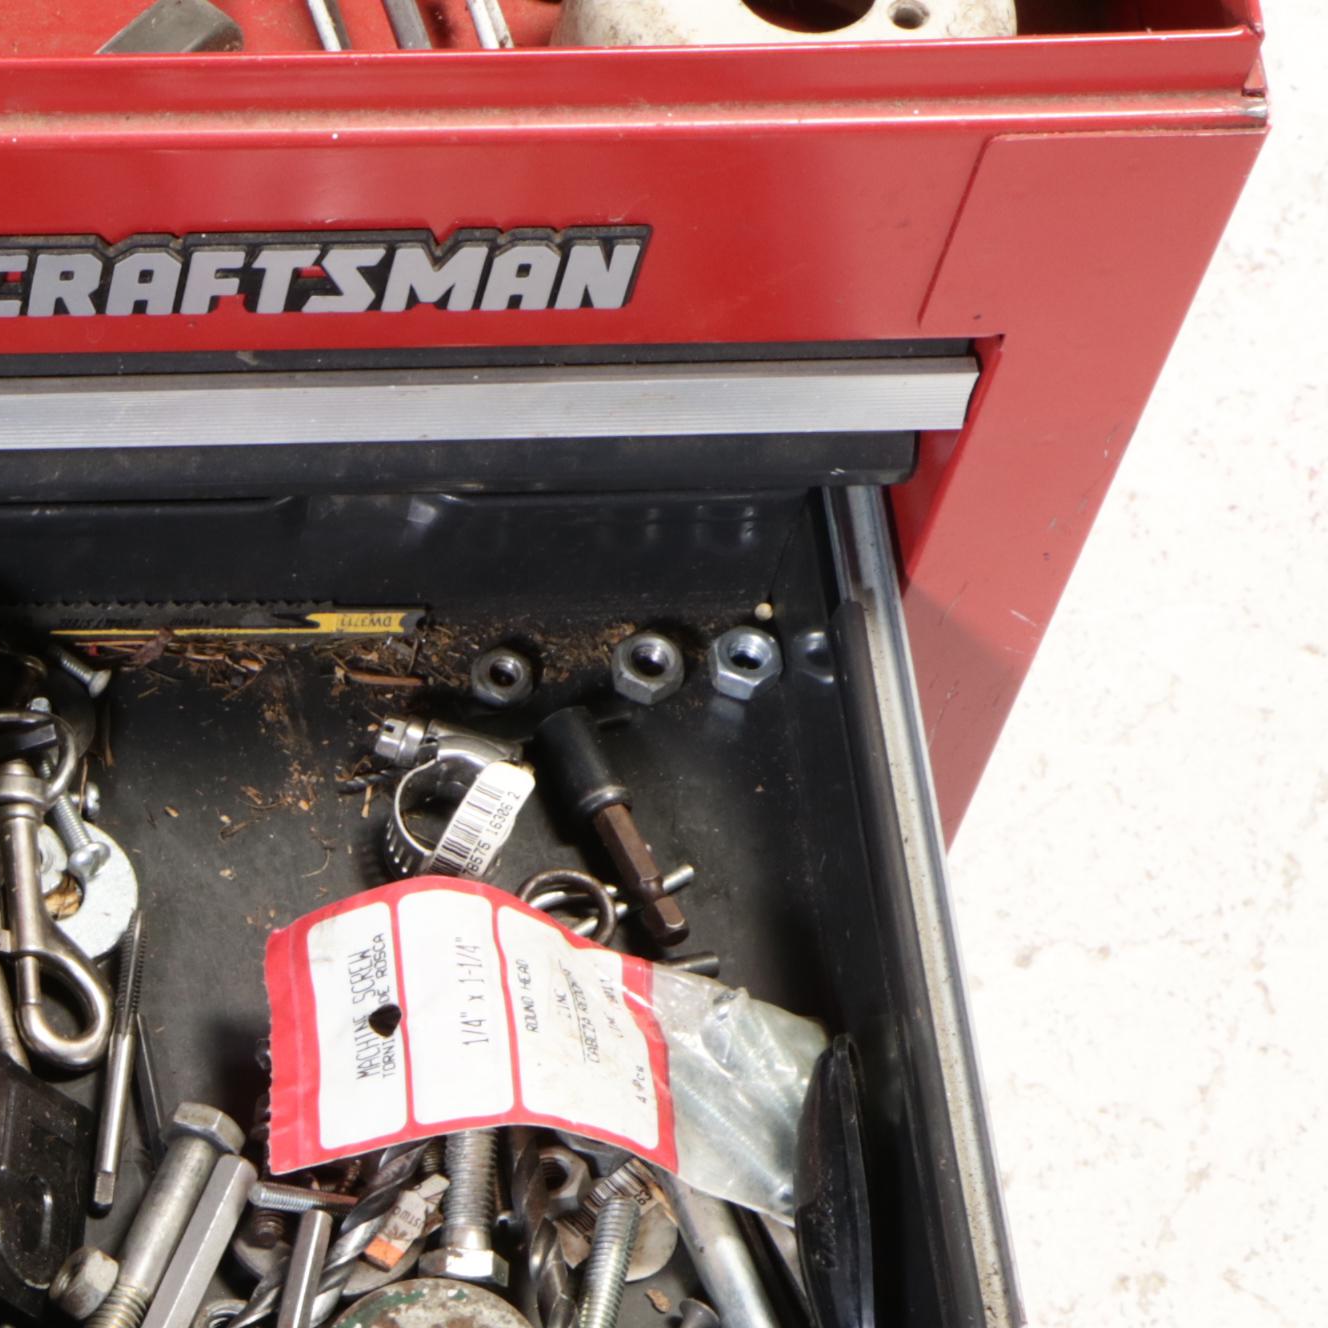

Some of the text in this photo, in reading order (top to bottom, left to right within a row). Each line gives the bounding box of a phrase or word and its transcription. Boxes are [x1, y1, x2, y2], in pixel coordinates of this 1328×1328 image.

[351, 947, 374, 1005] SCREW
[373, 932, 385, 977] ROSCA
[377, 985, 390, 1003] DE
[515, 958, 540, 1033] ROUND HEAD
